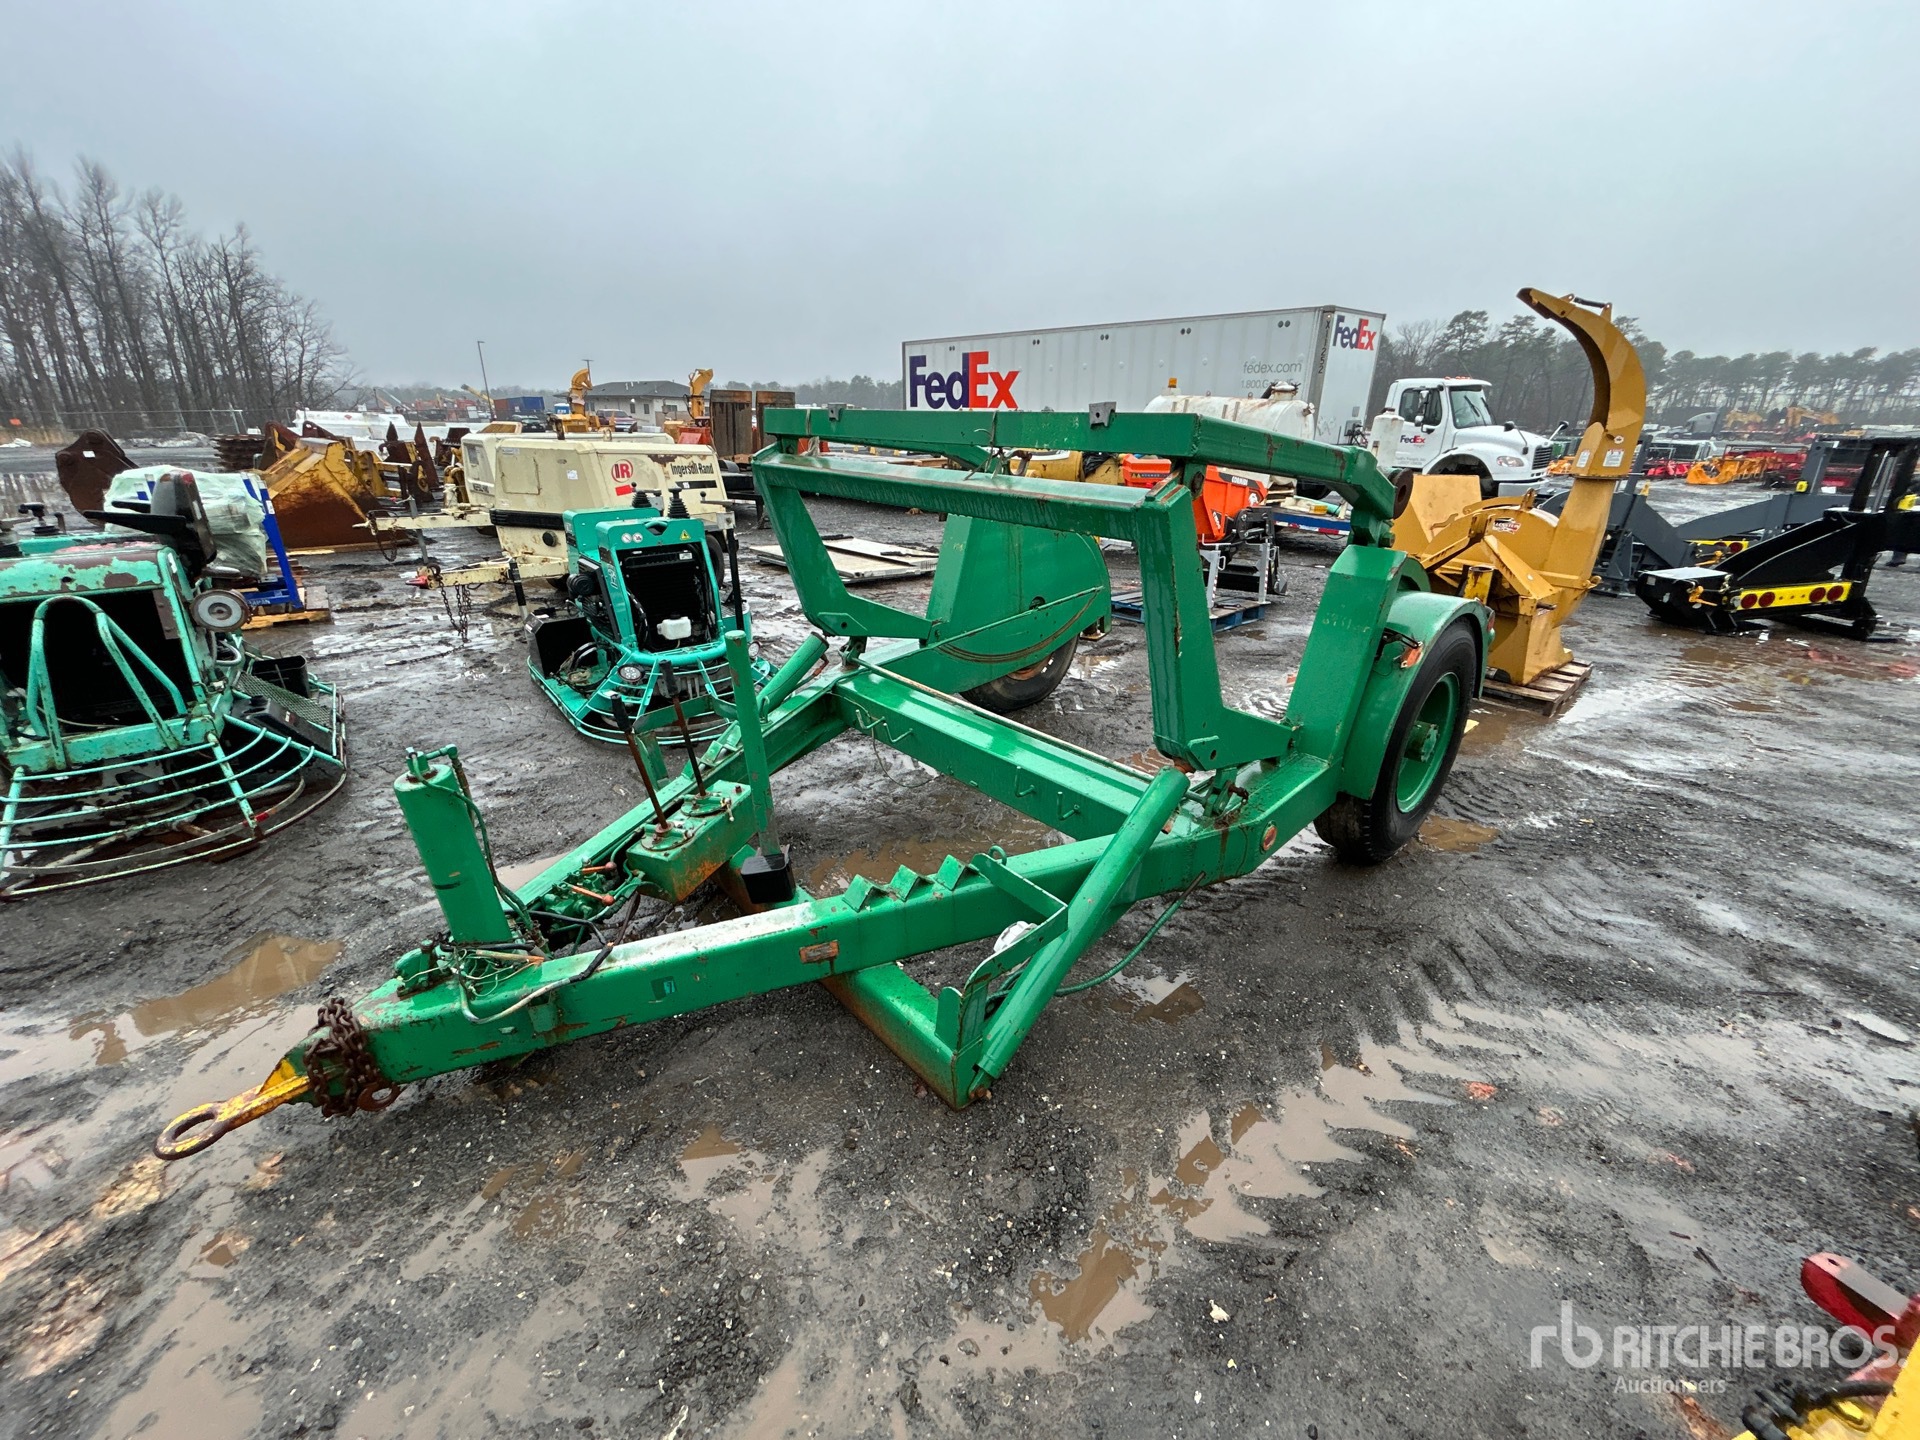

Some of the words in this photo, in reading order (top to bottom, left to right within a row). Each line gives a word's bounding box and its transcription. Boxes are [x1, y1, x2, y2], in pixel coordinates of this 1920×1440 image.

[1332, 314, 1377, 350] FedEx
[1243, 361, 1302, 374] fedex.com
[908, 351, 1020, 410] FedEx
[1400, 434, 1426, 444] FedEx
